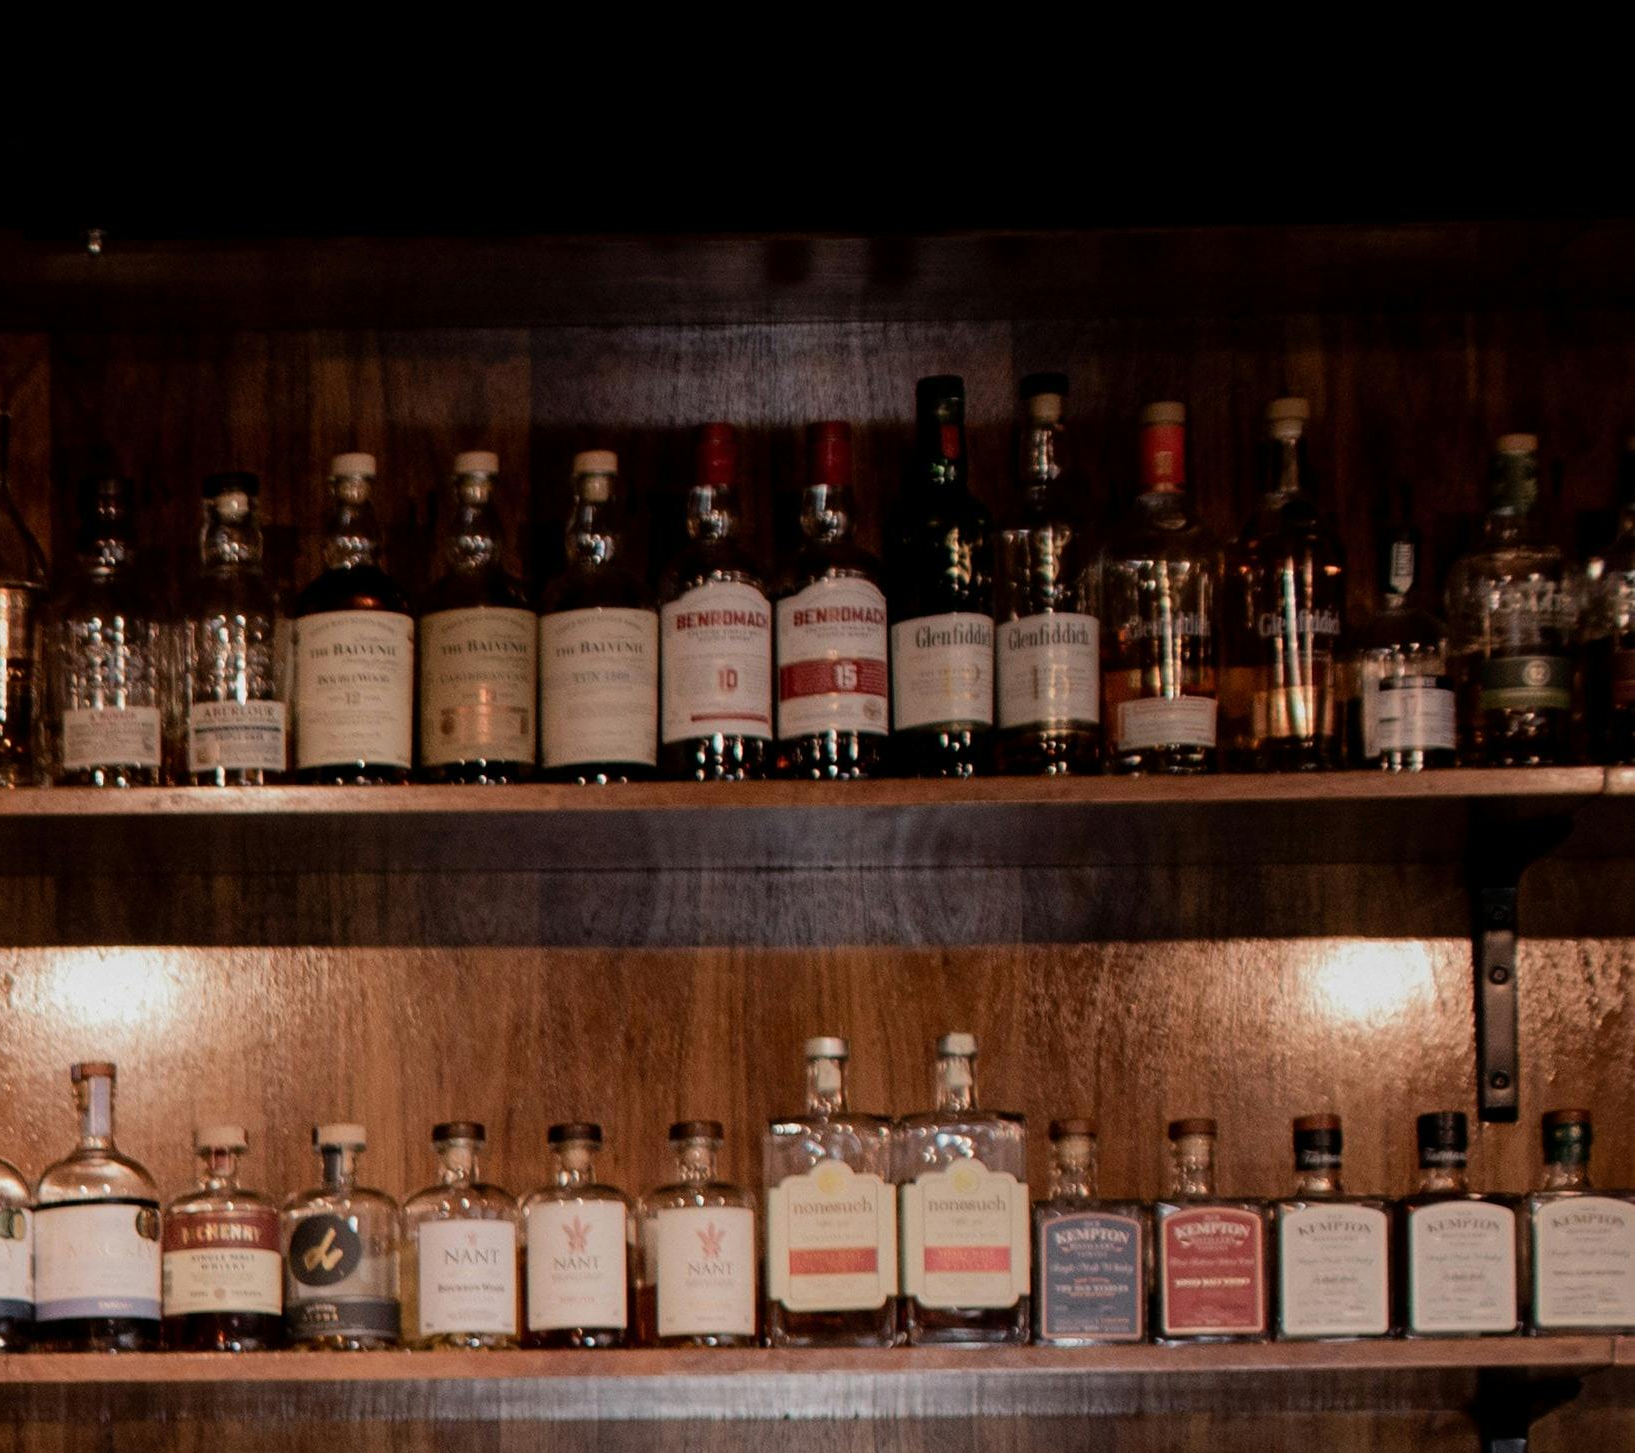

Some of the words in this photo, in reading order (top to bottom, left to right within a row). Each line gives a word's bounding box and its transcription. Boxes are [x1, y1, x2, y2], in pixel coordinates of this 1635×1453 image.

[443, 1249, 498, 1265] NANT
[552, 1257, 597, 1270] NANT
[688, 1262, 733, 1275] NANT
